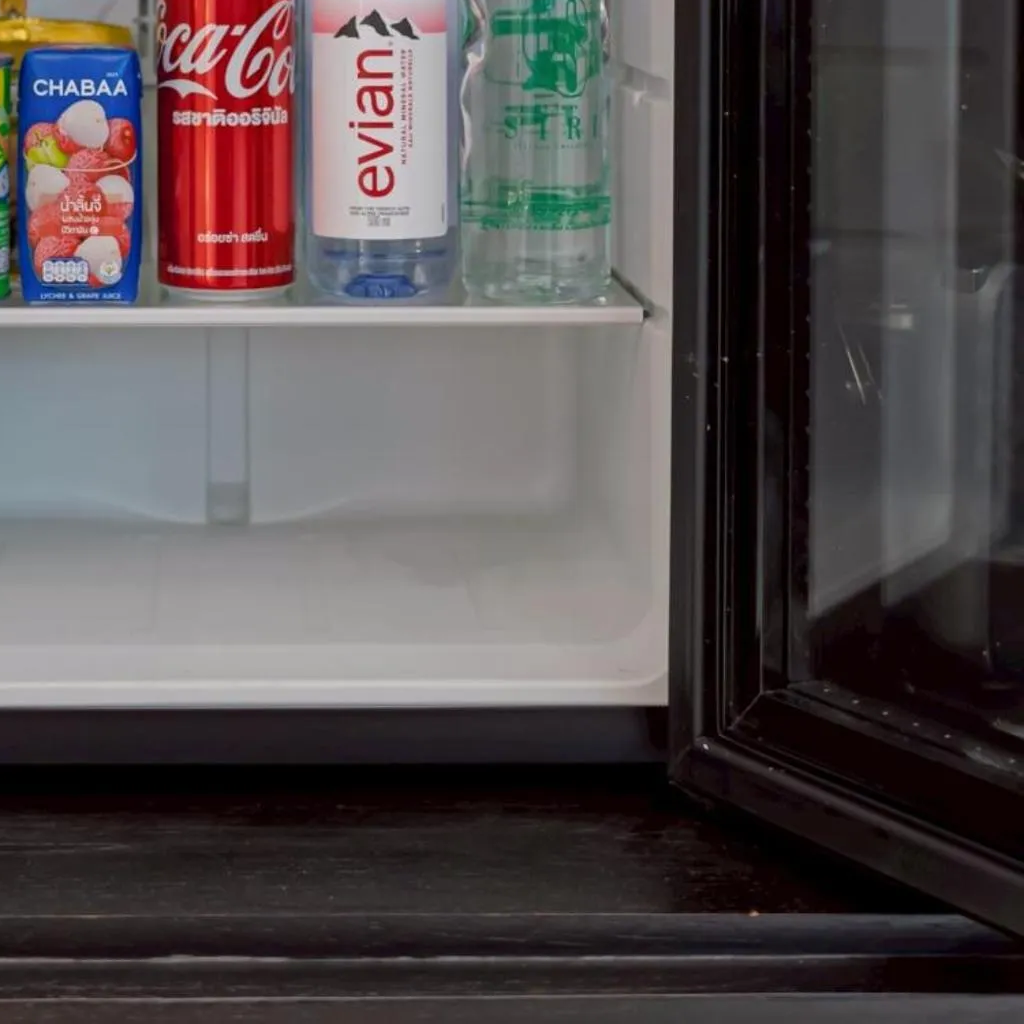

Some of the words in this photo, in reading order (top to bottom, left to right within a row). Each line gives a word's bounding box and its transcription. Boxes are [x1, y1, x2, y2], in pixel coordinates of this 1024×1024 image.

[33, 79, 129, 97] CHABAA
[400, 82, 408, 121] MINERAL
[348, 48, 395, 198] evian
[400, 125, 408, 165] NATURAL
